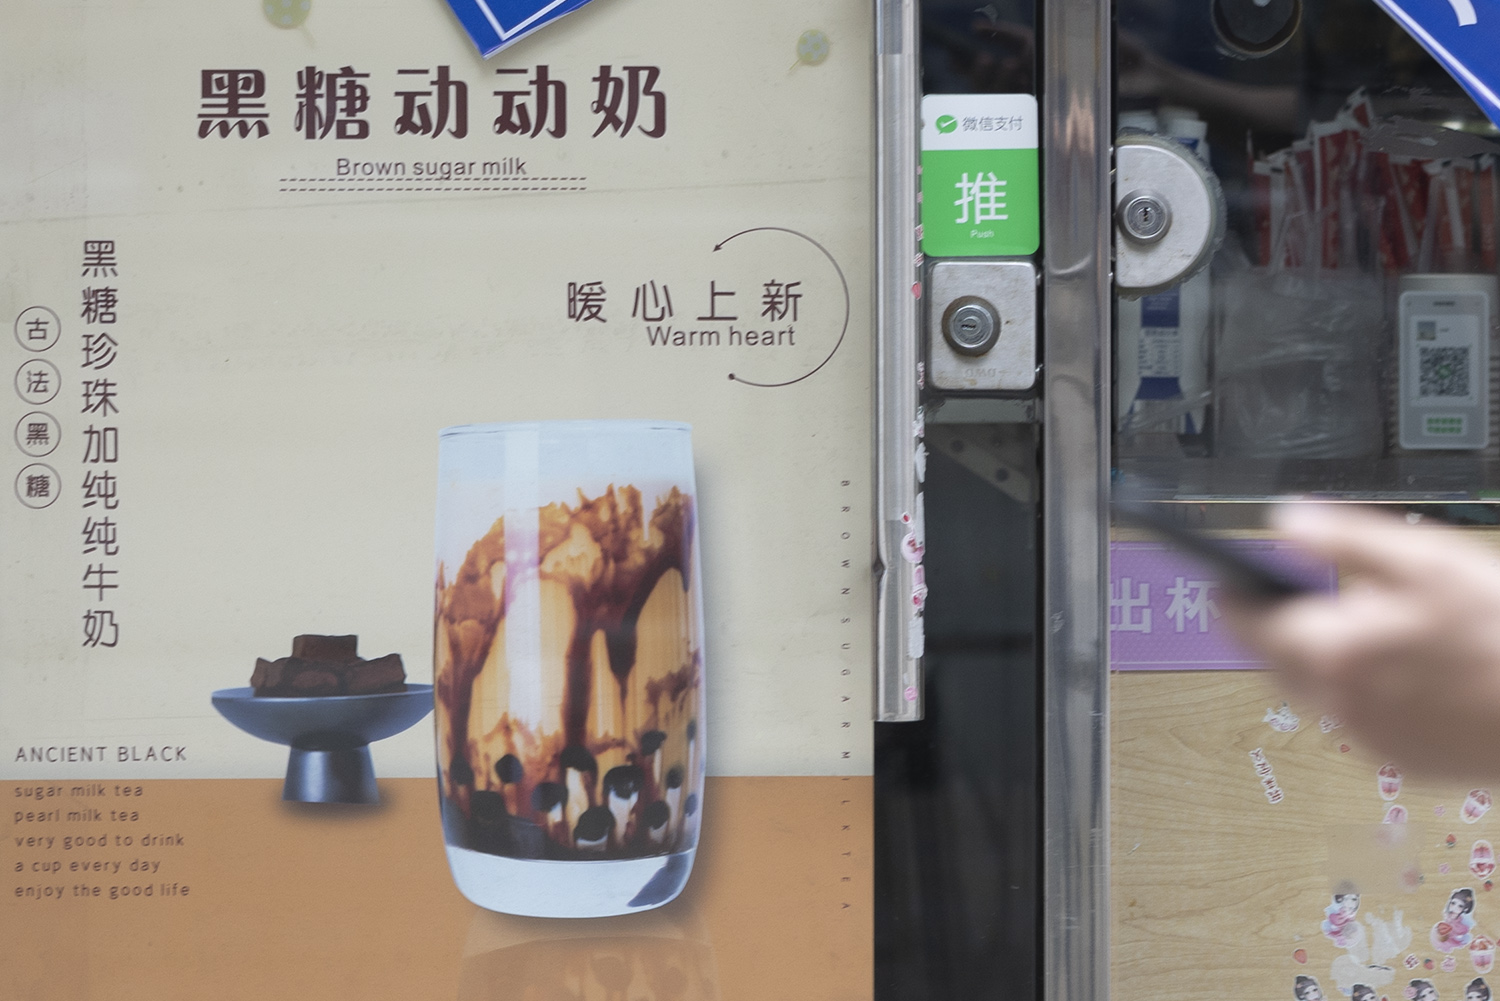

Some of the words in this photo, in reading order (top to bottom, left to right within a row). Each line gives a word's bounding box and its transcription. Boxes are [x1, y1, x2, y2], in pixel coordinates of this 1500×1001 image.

[197, 64, 667, 140] 黑糖动动奶
[962, 116, 1023, 132] 微信支付
[336, 157, 406, 176] Brown
[412, 161, 476, 181] sugar
[482, 157, 527, 175] milk
[954, 171, 1008, 225] 推
[970, 229, 995, 239] Push
[567, 279, 803, 323] 暖心上新
[646, 325, 720, 347] Warm
[728, 325, 796, 347] heart
[80, 239, 119, 648] 黑糖珍珠加纯纯牛奶
[840, 479, 851, 595] BROWN
[840, 617, 851, 729] SUGAR
[15, 746, 107, 763] ANCIENT
[117, 745, 187, 762] BLACK
[14, 785, 64, 801] sugar
[70, 784, 106, 797] milk
[114, 784, 144, 797] tea
[840, 750, 851, 831] MILK
[14, 809, 60, 825] pearl
[67, 809, 102, 822] milk
[111, 810, 140, 822] tea
[15, 837, 55, 849] very
[63, 834, 108, 850] good
[115, 835, 134, 847] to
[141, 834, 185, 847] drink
[14, 861, 24, 872] a
[31, 861, 62, 874] cup
[69, 861, 122, 873] every
[129, 859, 161, 873] day
[14, 884, 65, 900] enjoy
[72, 884, 101, 897] the
[109, 884, 154, 900] good
[160, 883, 191, 897] life
[840, 851, 851, 910] TEA
